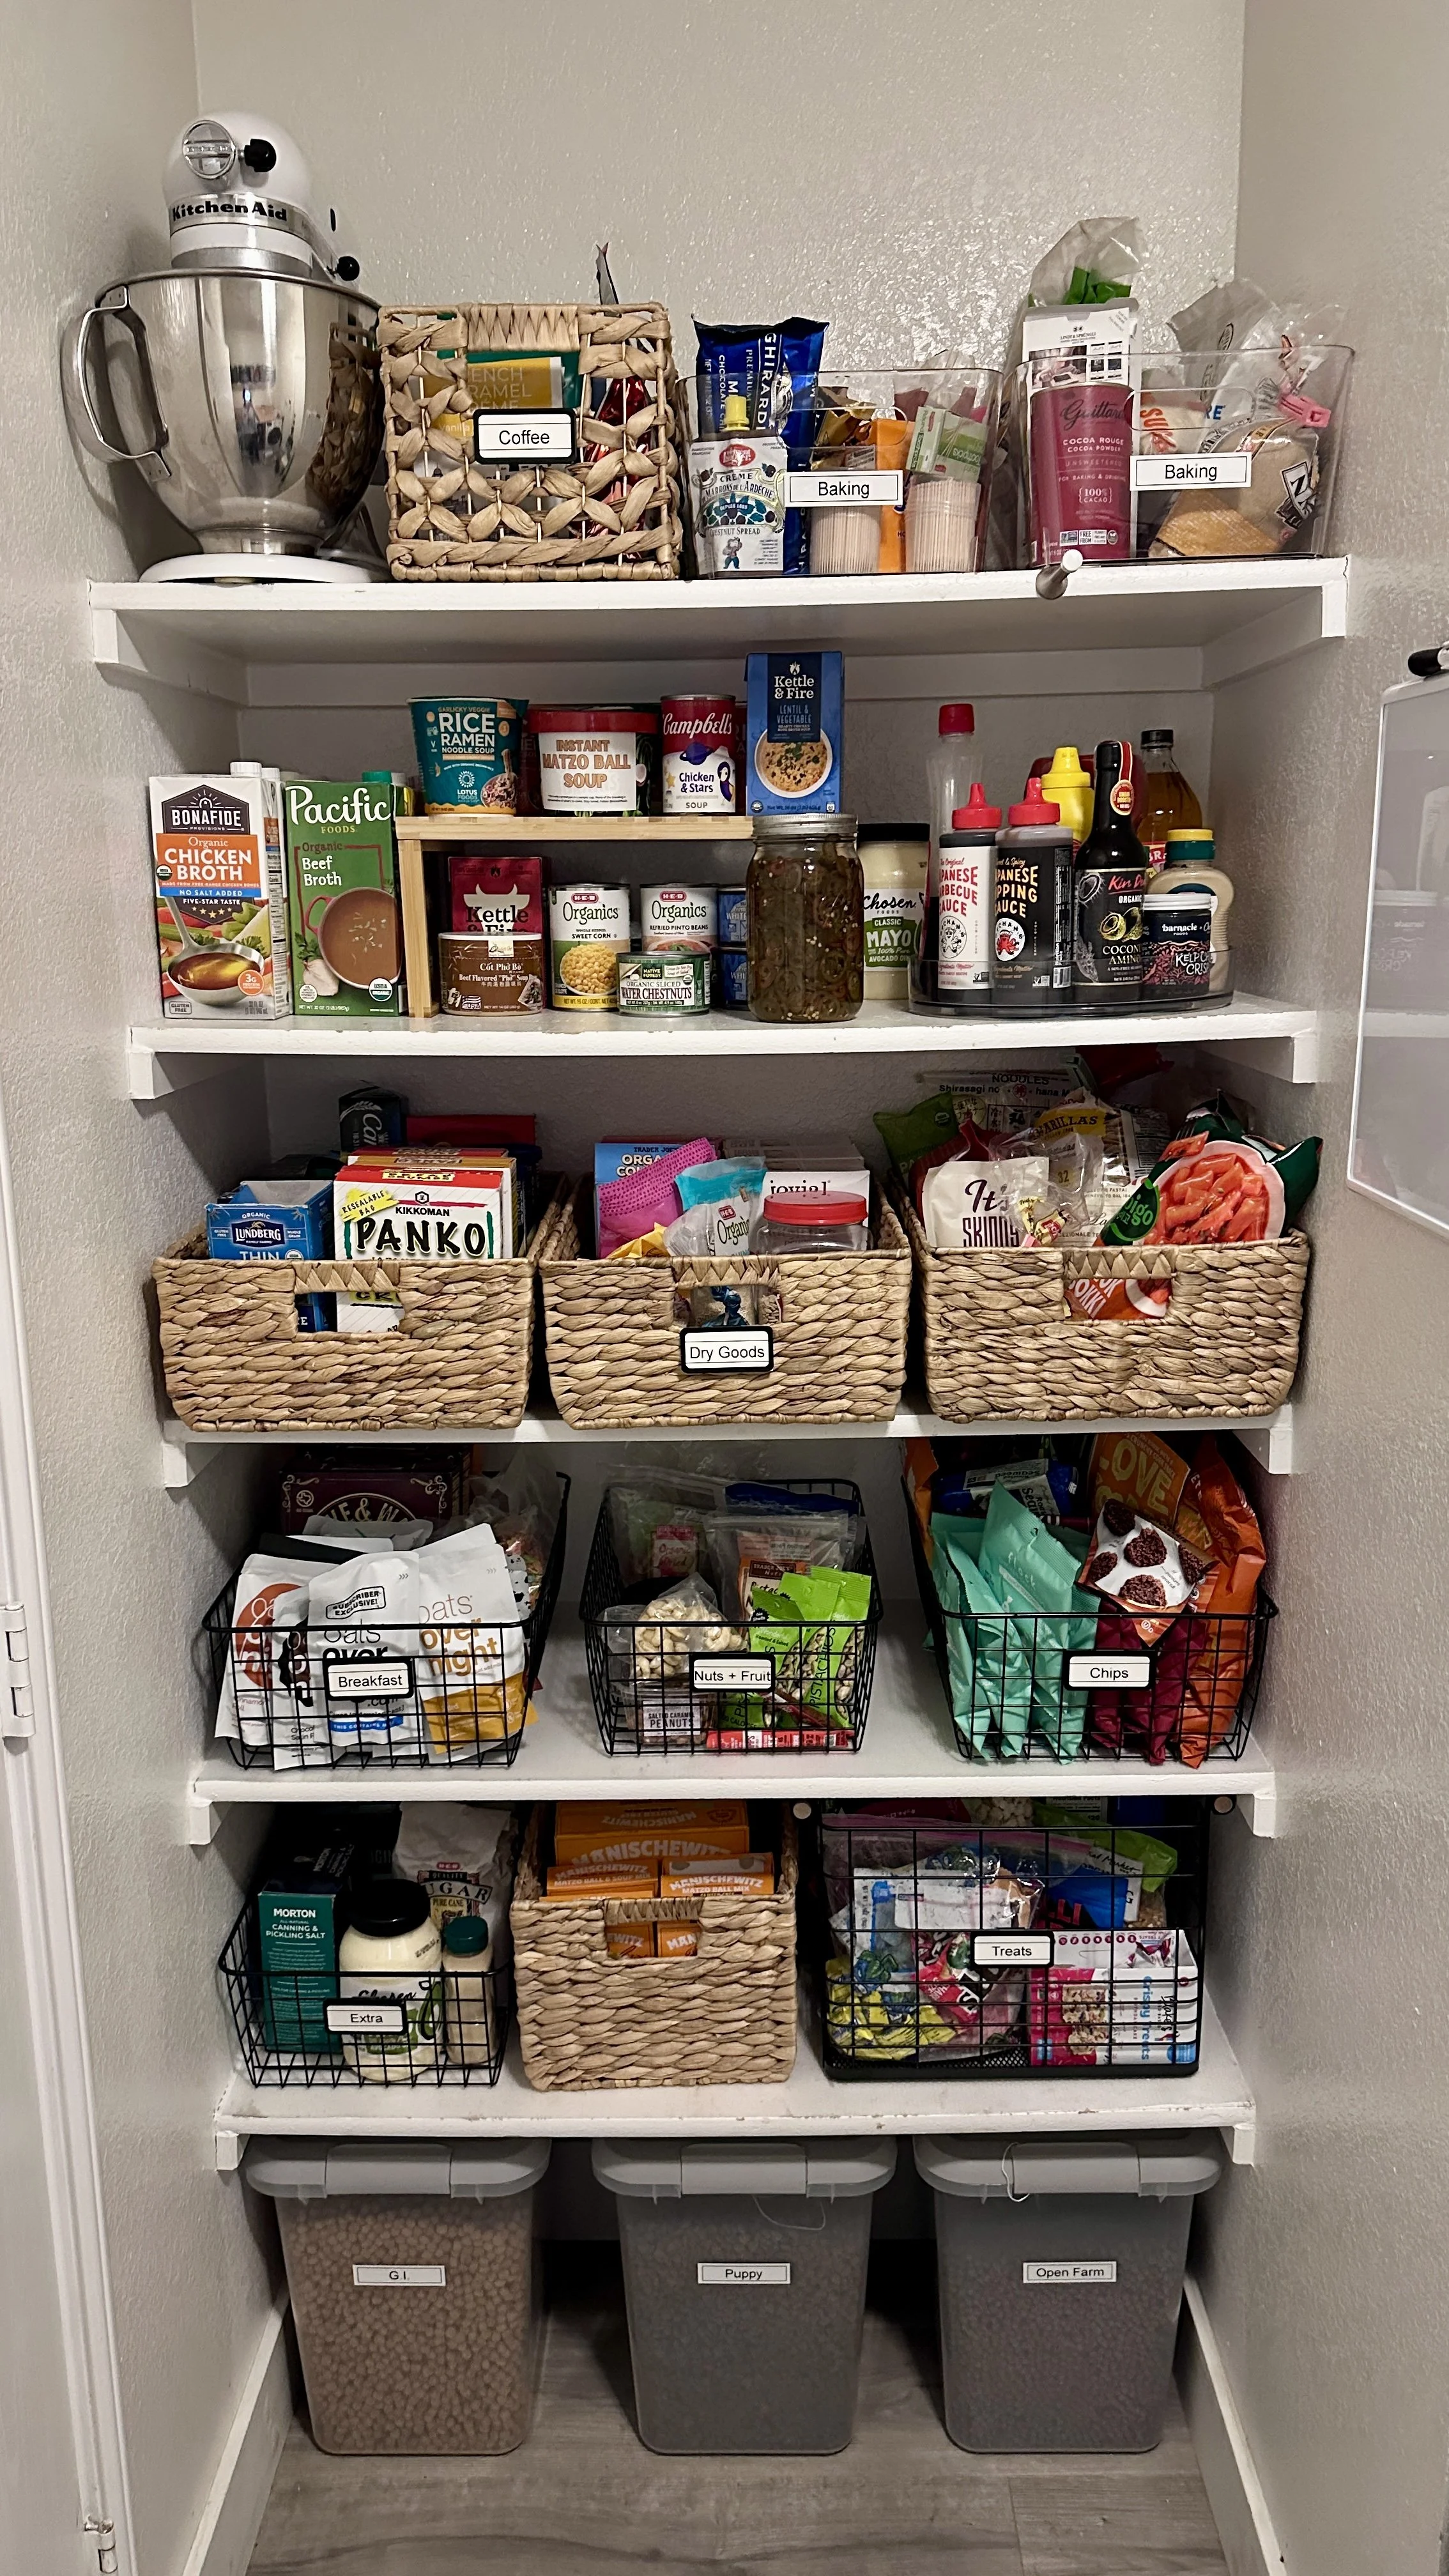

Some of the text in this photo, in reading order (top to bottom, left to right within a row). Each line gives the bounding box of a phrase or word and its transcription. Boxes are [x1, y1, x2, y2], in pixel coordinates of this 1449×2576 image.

[172, 201, 288, 222] KitchenAid
[756, 332, 777, 431] GHIRARD
[1060, 399, 1127, 431] Guittar
[498, 429, 550, 445] Coffee
[1062, 437, 1124, 445] COCOA ROUGE
[1165, 464, 1218, 481] Baking
[704, 484, 733, 498] MARRONS
[818, 481, 870, 499] Baking
[1084, 488, 1108, 497] 100%
[736, 526, 760, 535] SPREAD
[774, 674, 815, 687] Kettle
[774, 687, 814, 700] & Fire
[779, 705, 809, 715] LENTIL &
[438, 712, 495, 733] RICE
[662, 712, 732, 739] Campbell's
[776, 714, 812, 724] VEGETABLE
[440, 733, 495, 747] RAMEN
[556, 739, 610, 752] INSTANT
[542, 753, 631, 770] MATZO BALL
[563, 772, 608, 788] SOUP
[678, 772, 714, 783] Chicken
[680, 783, 714, 793] & Stars
[285, 785, 392, 825] Pacific
[171, 809, 242, 827] BONAFIDE
[188, 836, 229, 849] Organic
[302, 841, 343, 856] Organic
[164, 848, 252, 865] CHICKEN
[302, 855, 334, 871] Beef
[945, 857, 965, 869] Original
[1010, 857, 1026, 869] Spicy
[176, 864, 243, 881] BROTH
[303, 871, 342, 887] Broth
[1108, 875, 1131, 891] Kin
[864, 892, 916, 910] Chosen
[466, 905, 529, 923] Kettle
[563, 901, 619, 925] Organics
[652, 900, 707, 923] Organics
[874, 918, 902, 926] CLASSIC
[1162, 922, 1197, 932] barnacle
[866, 929, 912, 948] MAYO
[1175, 951, 1200, 967] KELP
[620, 987, 692, 1000] WATER CHESTNUTS
[939, 1084, 986, 1093] Shirasagi
[1035, 1088, 1059, 1096] hana
[341, 1190, 385, 1214] RESEALABLE
[964, 1179, 1009, 1213] It's
[241, 1211, 271, 1220] ORGANIC
[358, 1206, 376, 1217] BAG
[395, 1206, 450, 1217] KIKKOMAN
[235, 1227, 282, 1242] LUNDBERG
[356, 1216, 486, 1256] PANKO
[239, 1250, 280, 1261] THIN
[689, 1345, 765, 1363] Dry Goods
[332, 1590, 379, 1610] SUBSCRIBER
[334, 1598, 378, 1616] EXCLUSIVE!
[419, 1593, 473, 1624] oats
[694, 1670, 771, 1682] Nuts + Fruit
[1089, 1666, 1130, 1682] Chips
[338, 1675, 403, 1688] Breakfast
[583, 1877, 604, 1885] BALL
[669, 1874, 764, 1891] MANISCHEWITZ
[712, 1885, 733, 1894] BALL
[733, 1885, 750, 1893] MIX
[448, 1898, 464, 1907] CANE
[273, 1908, 316, 1919] MORTON
[265, 1930, 303, 1939] PICKLING
[272, 1924, 310, 1932] CANNING
[992, 1945, 1032, 1957] Treats
[350, 2012, 384, 2024] Extra
[389, 2270, 411, 2280] G.I.
[725, 2269, 763, 2280] Puppy
[1036, 2267, 1105, 2279] Open Farm
